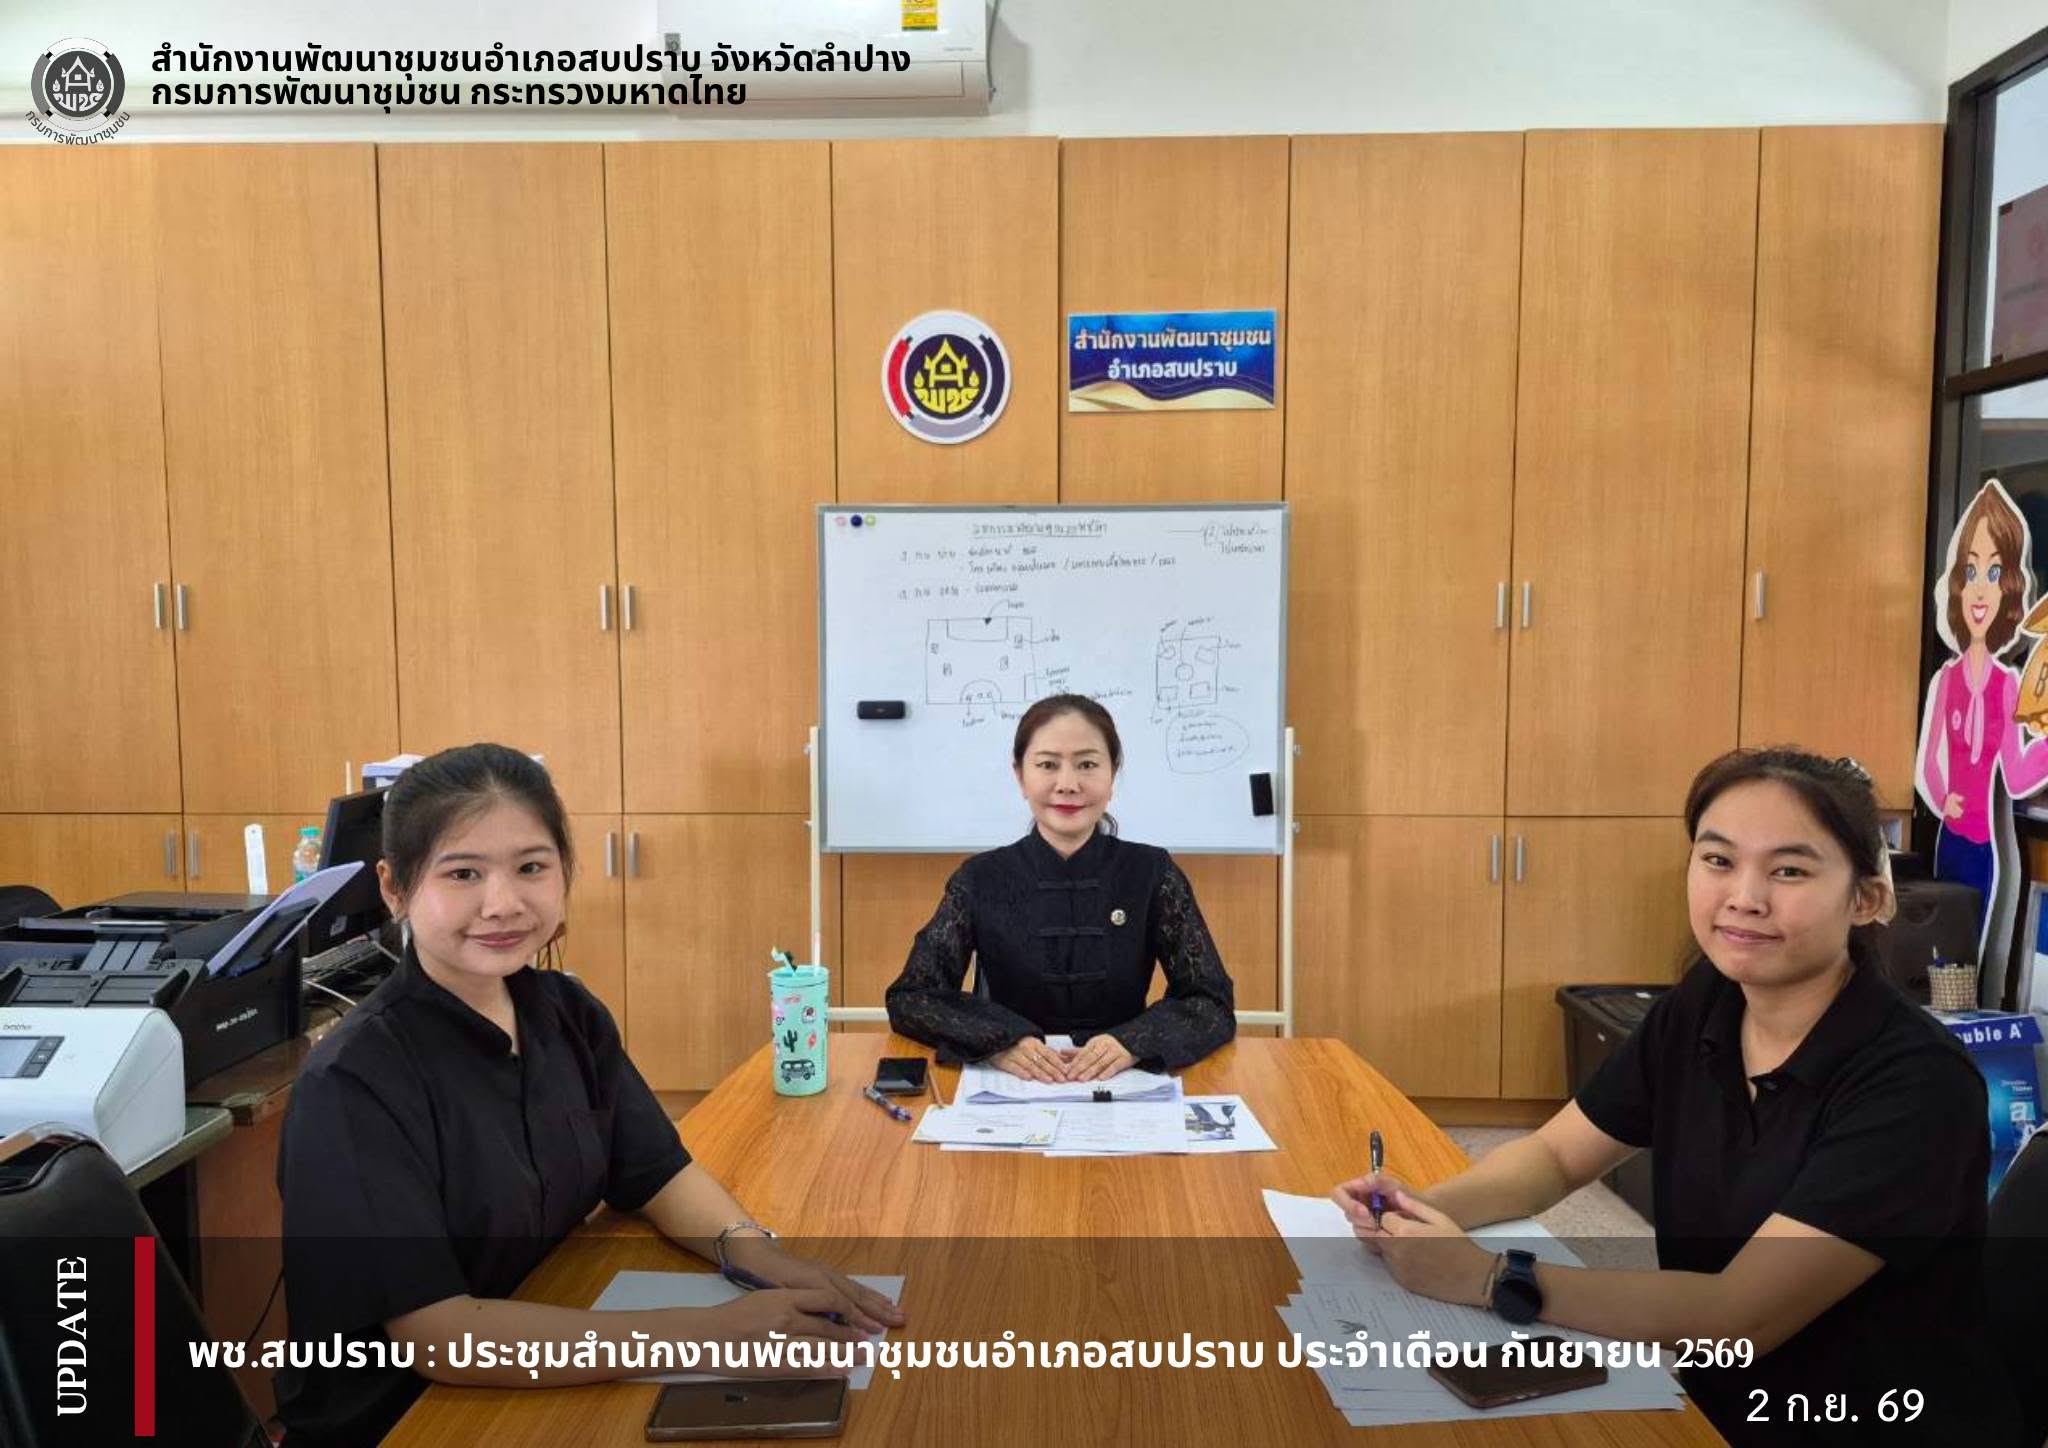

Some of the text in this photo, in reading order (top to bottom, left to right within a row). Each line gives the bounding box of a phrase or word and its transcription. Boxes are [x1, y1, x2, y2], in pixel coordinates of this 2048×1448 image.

[1074, 327, 1271, 352] สำนักงานพัฒนาชุมชน
[1107, 357, 1238, 380] อำเภอสบปราบ
[1955, 1022, 2022, 1045] uble A
